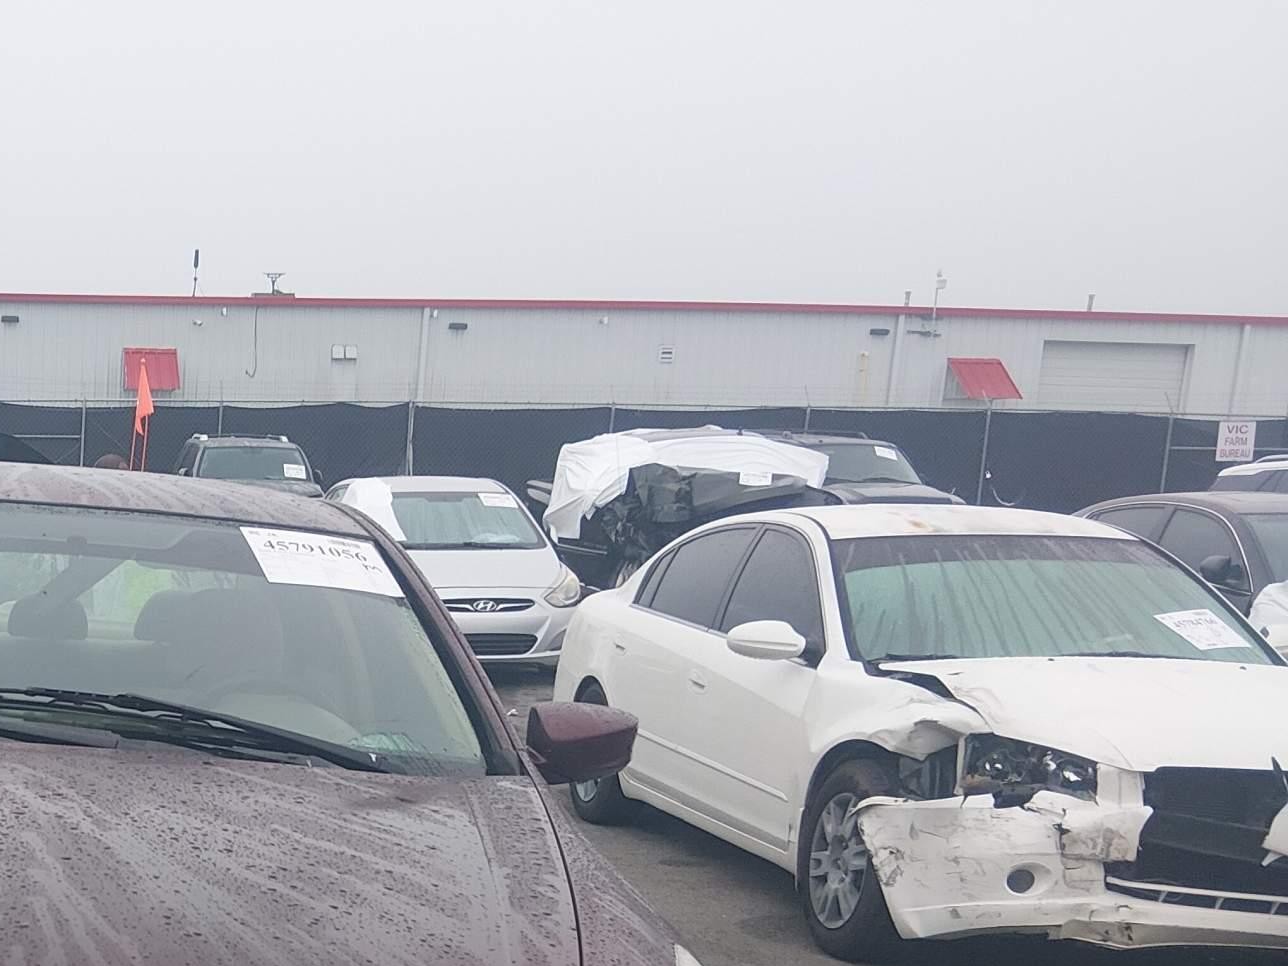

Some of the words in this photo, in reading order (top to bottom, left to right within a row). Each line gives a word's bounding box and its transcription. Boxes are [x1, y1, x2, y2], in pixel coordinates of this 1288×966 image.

[1227, 424, 1249, 434] VIC
[1224, 437, 1248, 446] FARM
[263, 539, 368, 563] 45791056
